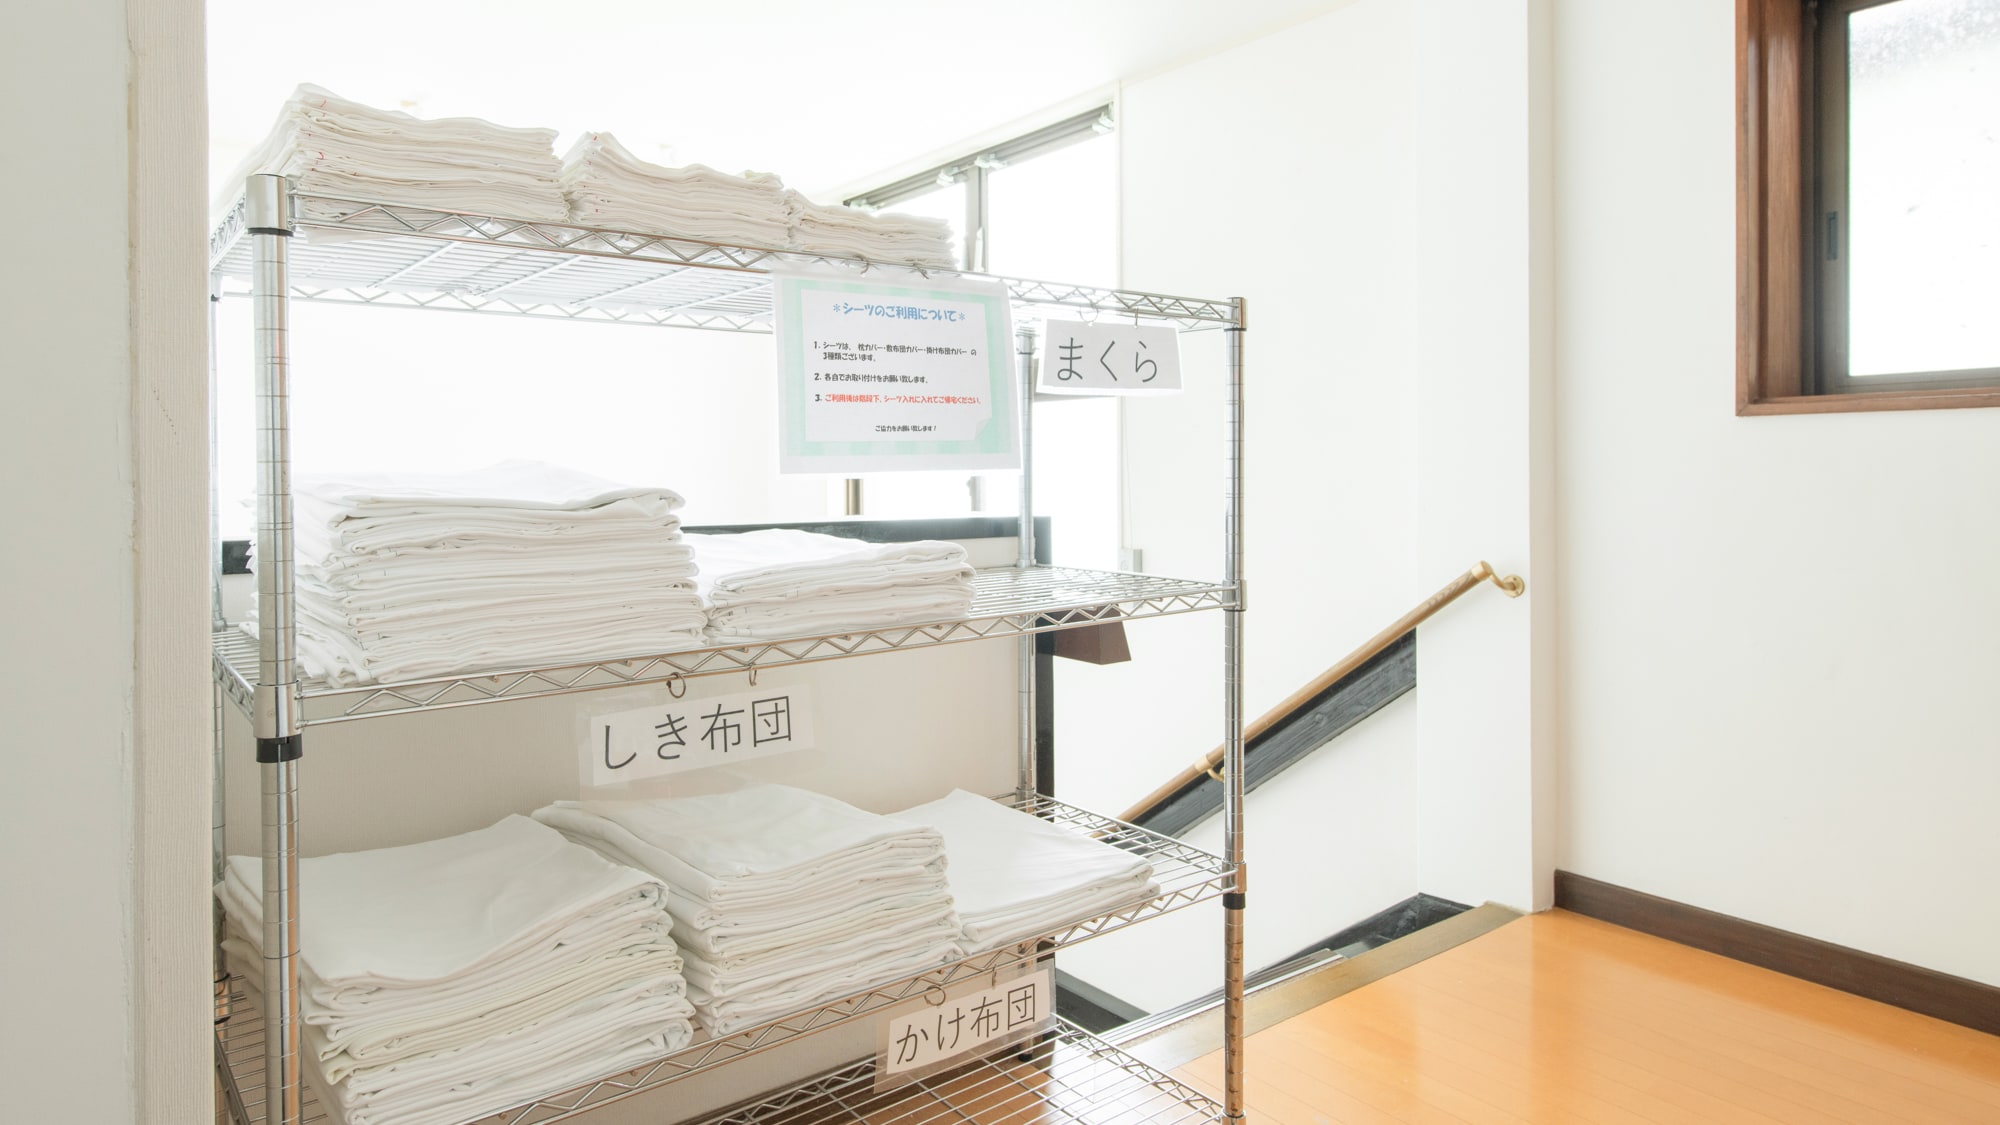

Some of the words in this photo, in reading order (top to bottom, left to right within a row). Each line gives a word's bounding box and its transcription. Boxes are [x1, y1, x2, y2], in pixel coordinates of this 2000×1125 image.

[1057, 337, 1157, 383] まくら
[605, 696, 791, 769] しき布団
[896, 983, 1036, 1064] かけ布団
